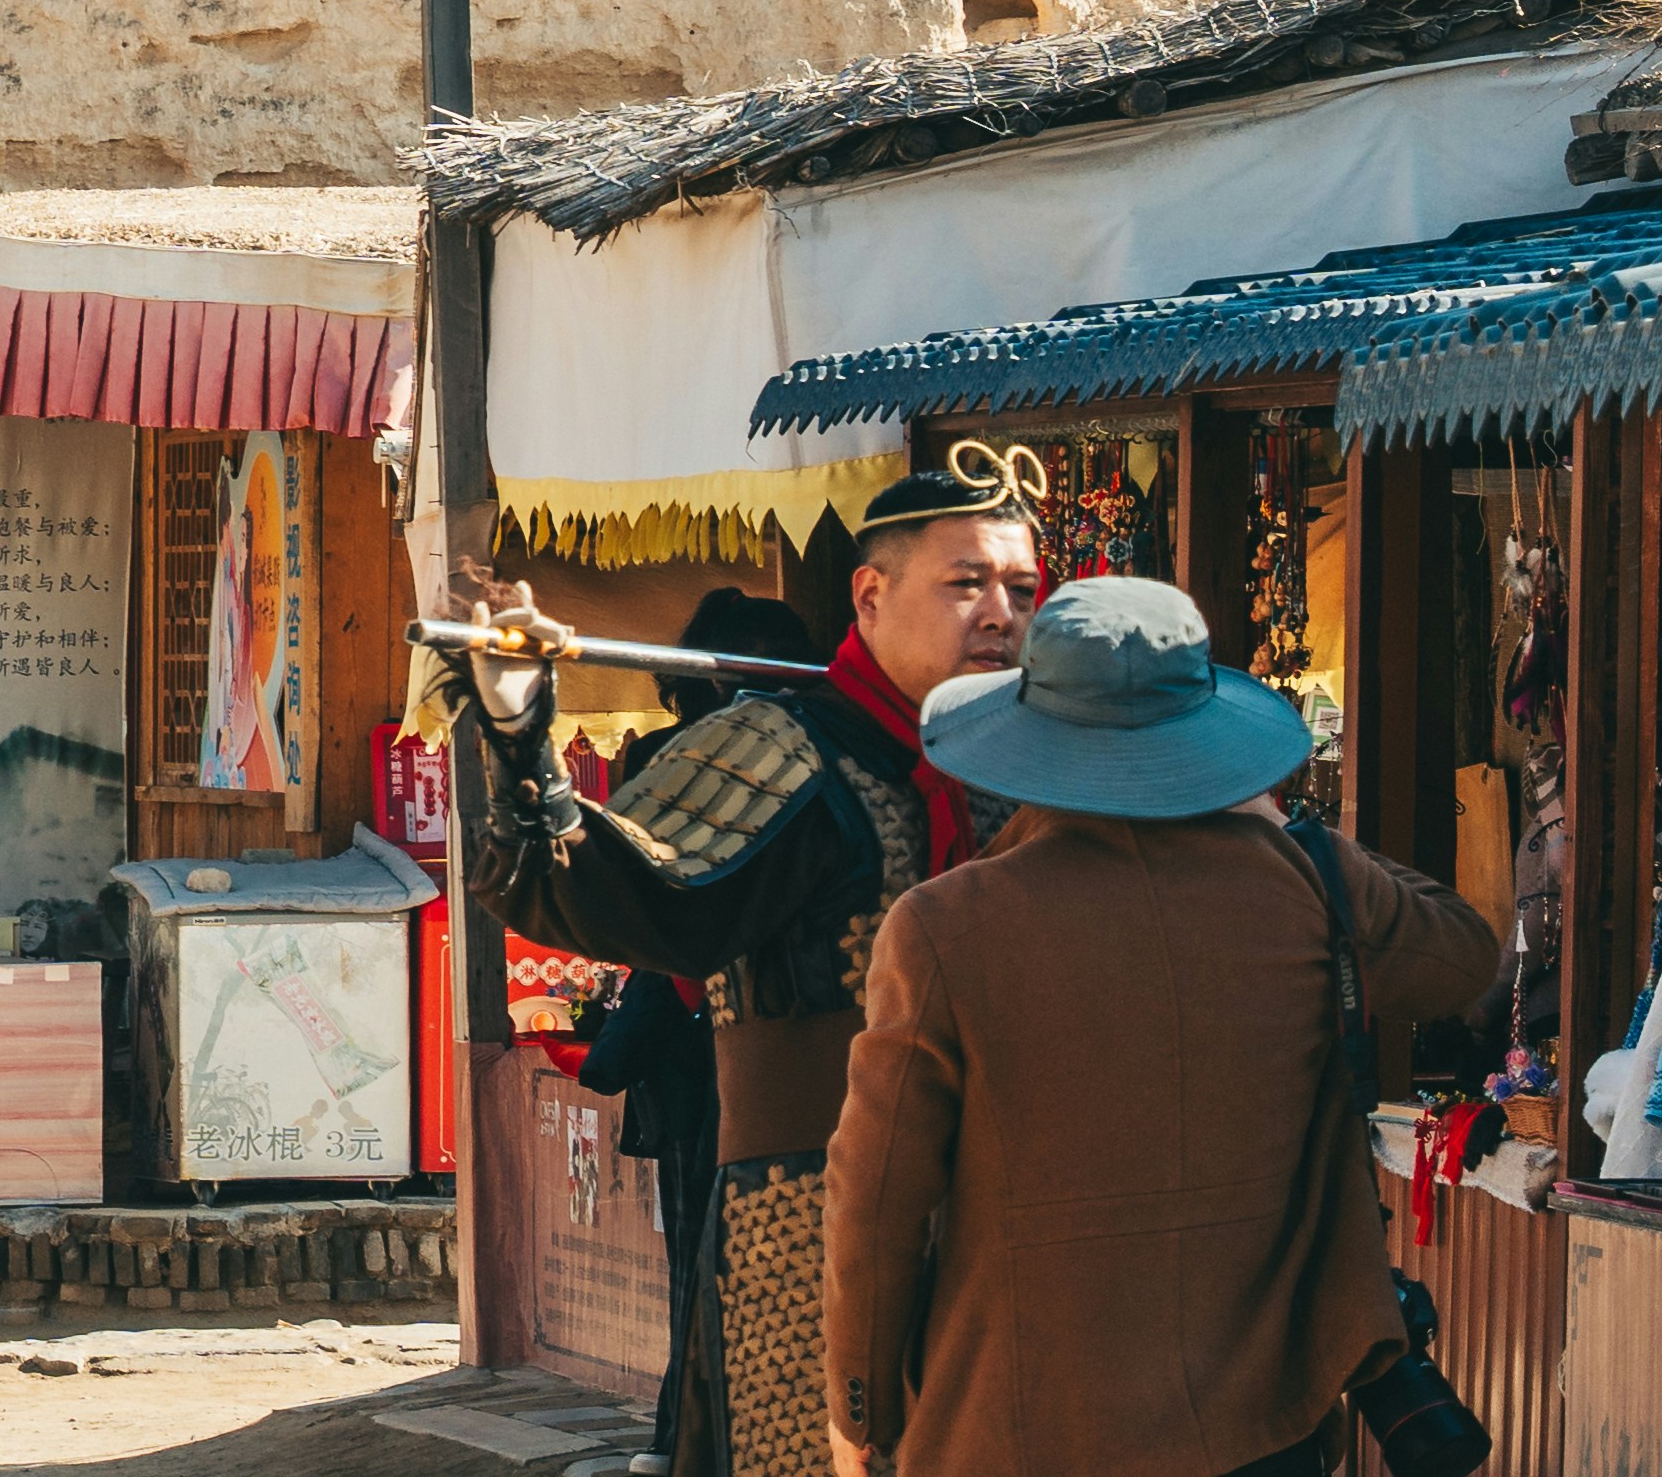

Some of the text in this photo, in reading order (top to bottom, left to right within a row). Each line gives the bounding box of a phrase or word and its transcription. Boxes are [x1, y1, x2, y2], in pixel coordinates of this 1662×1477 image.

[286, 456, 301, 786] 影视咨询处
[1337, 937, 1356, 1010] Canon
[187, 1125, 384, 1162] 老冰棍 3元
